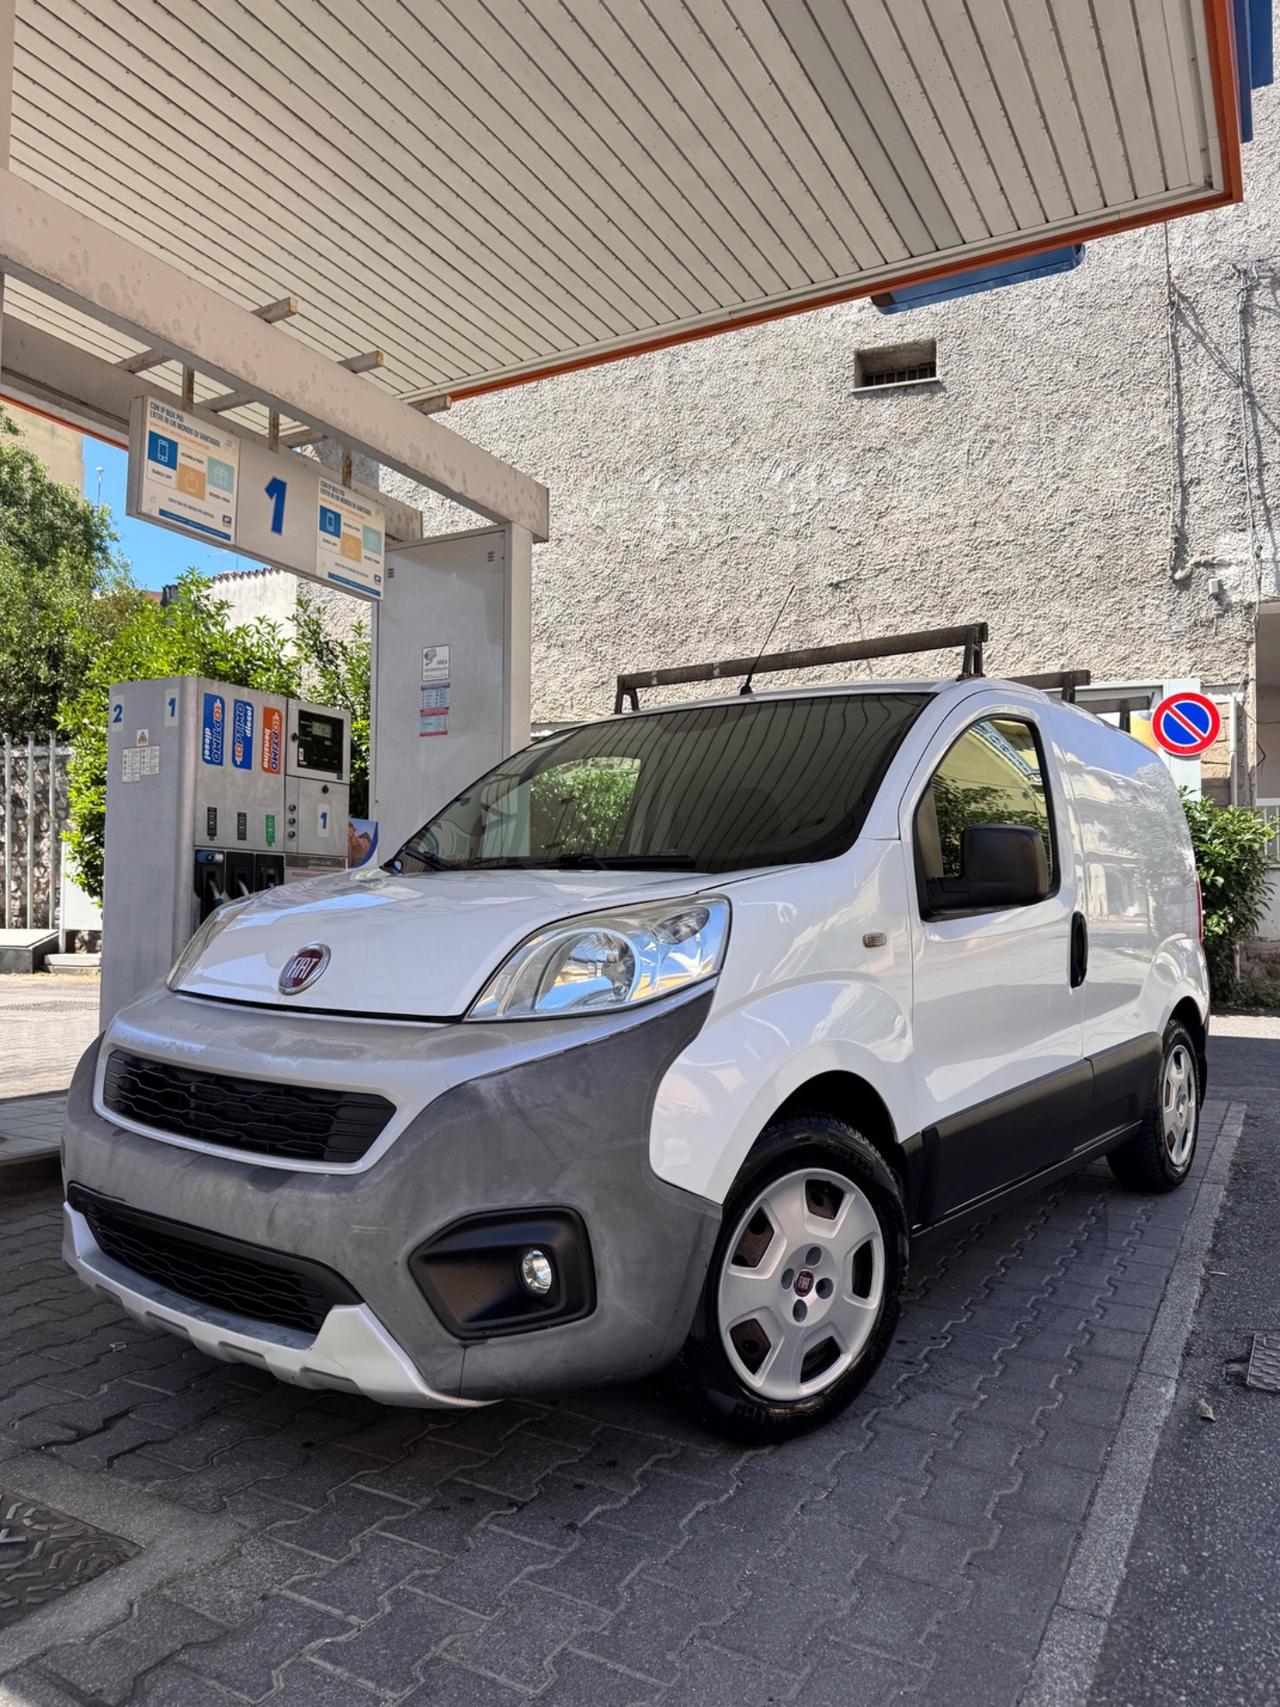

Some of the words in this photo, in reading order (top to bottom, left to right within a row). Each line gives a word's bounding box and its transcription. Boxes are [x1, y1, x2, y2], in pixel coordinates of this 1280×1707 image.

[150, 401, 160, 411] CON
[166, 408, 176, 418] BOX
[264, 476, 287, 536] 1
[112, 703, 123, 723] 2
[168, 697, 176, 717] 1
[245, 705, 253, 737] diesel
[204, 728, 212, 761] diesel
[263, 728, 271, 769] benzina
[320, 811, 328, 829] 1
[286, 955, 319, 979] FIAT
